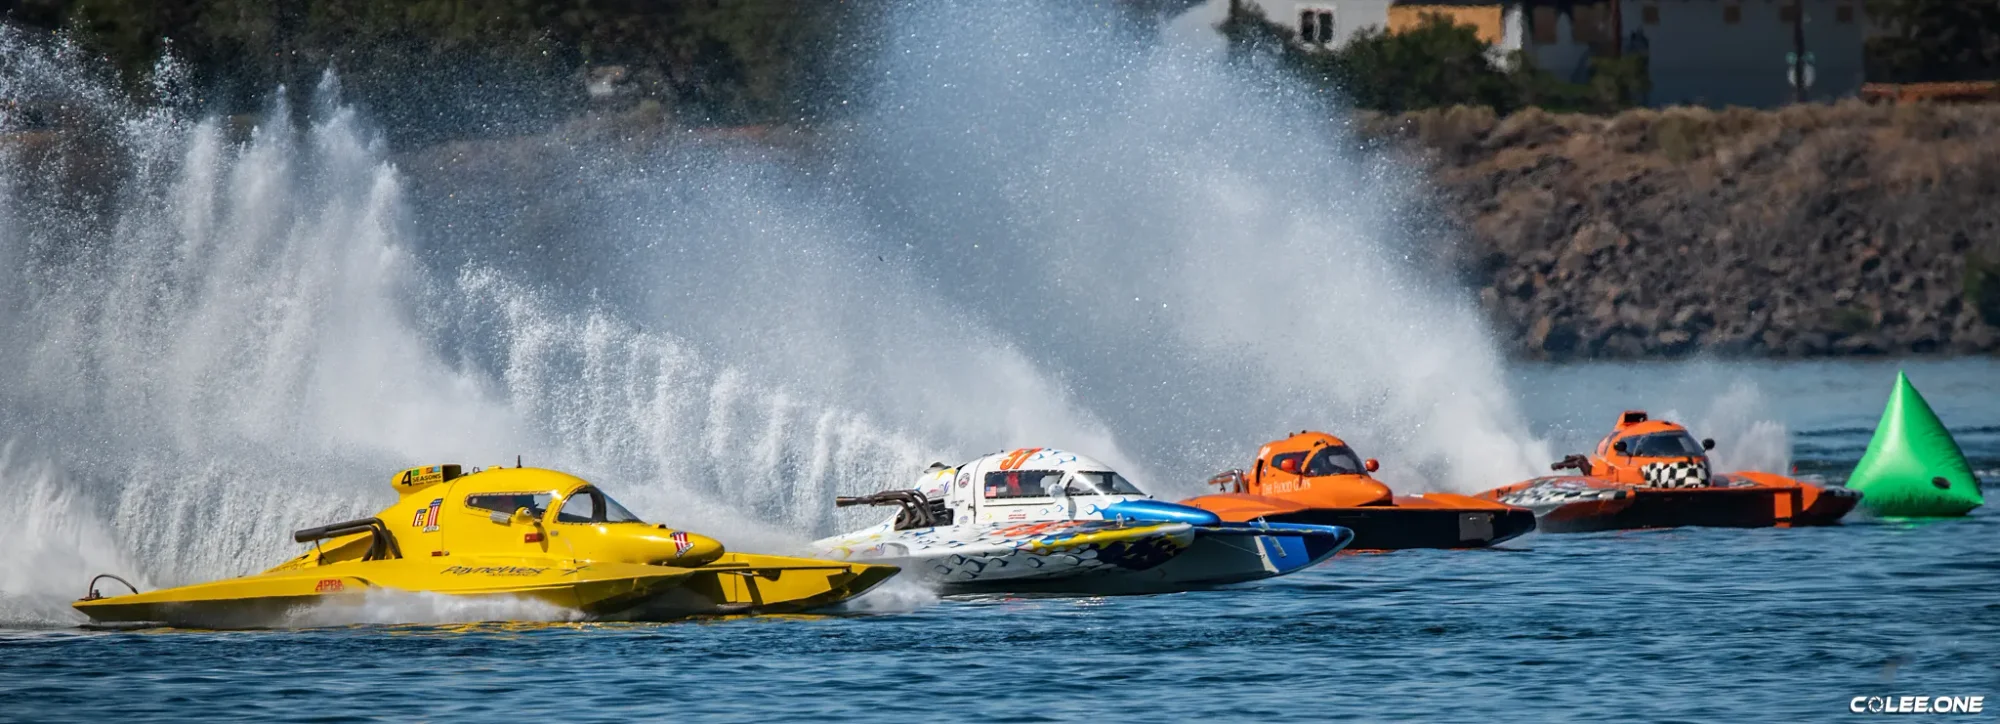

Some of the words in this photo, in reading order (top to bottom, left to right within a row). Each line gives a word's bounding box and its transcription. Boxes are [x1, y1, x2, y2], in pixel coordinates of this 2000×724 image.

[401, 470, 412, 486] 4
[412, 474, 441, 482] SEASONS
[1274, 480, 1292, 493] FLOOD
[314, 579, 344, 592] APBA
